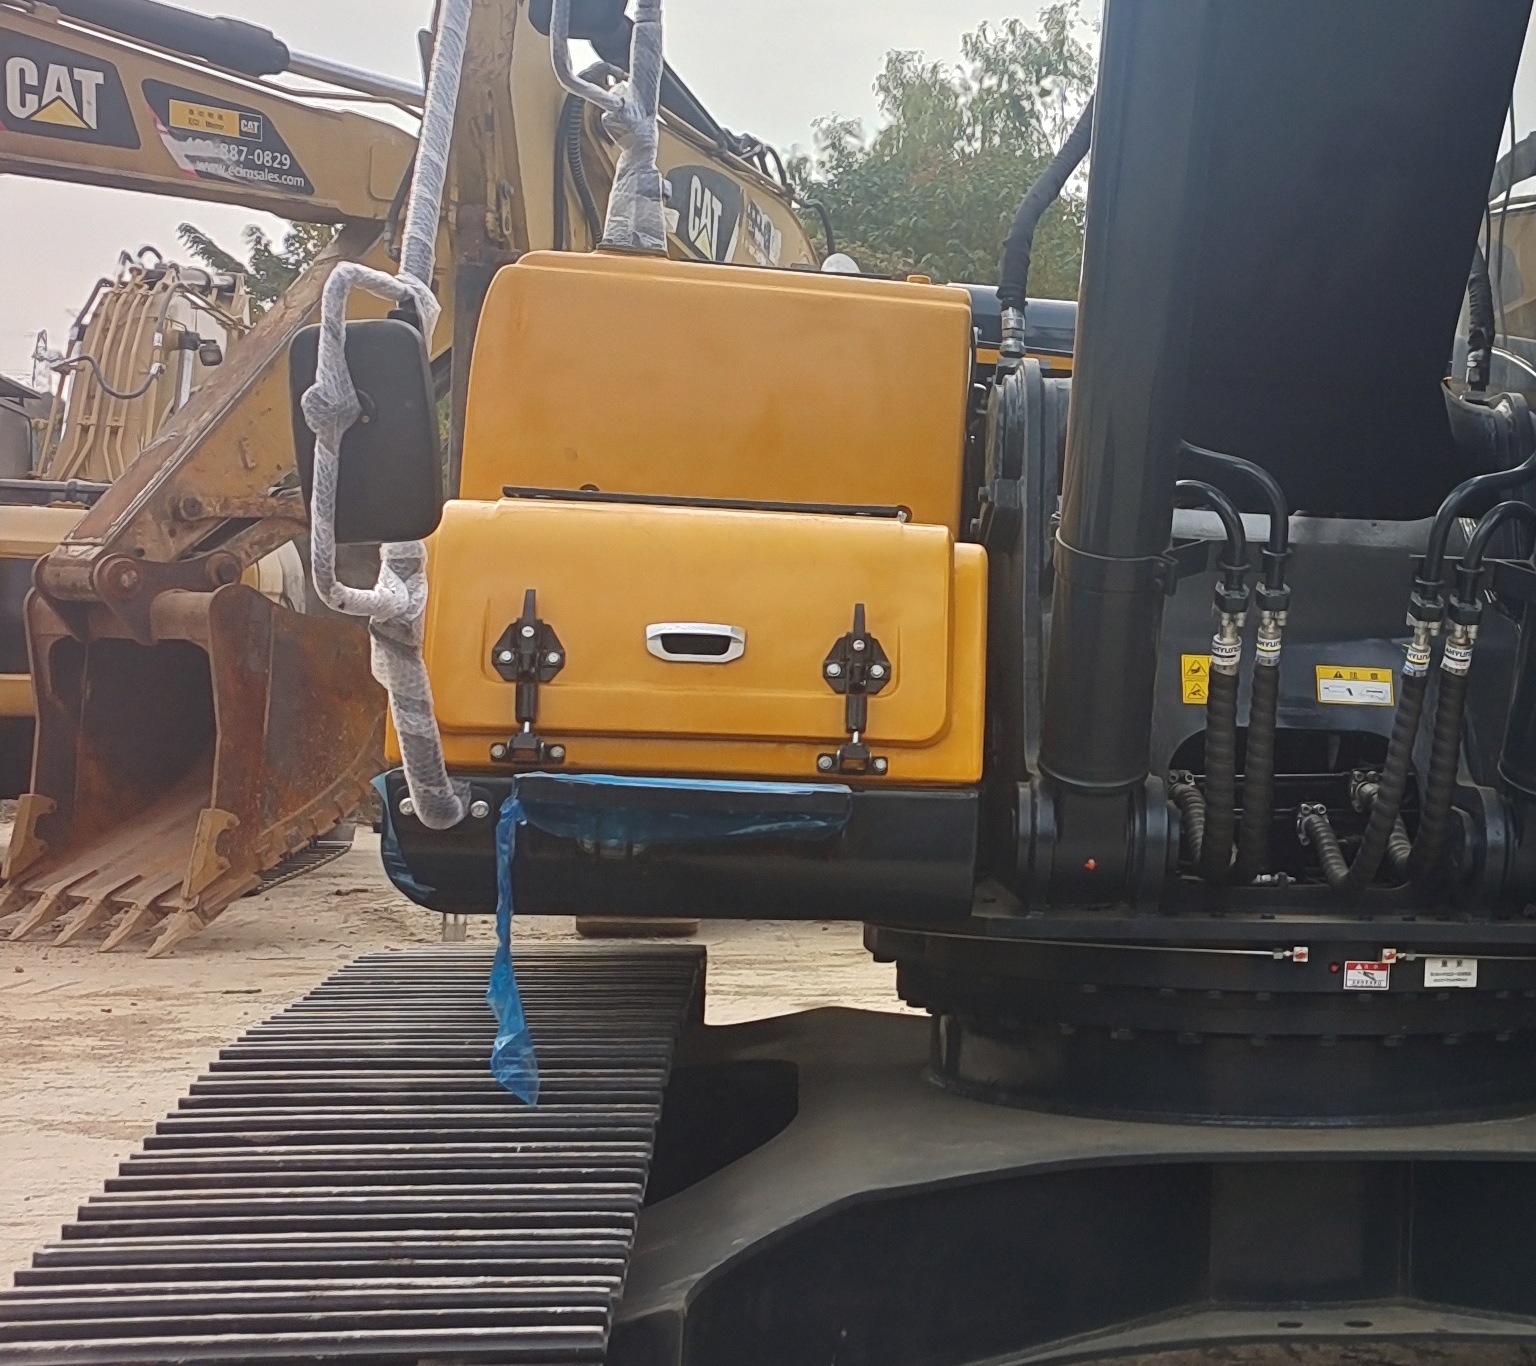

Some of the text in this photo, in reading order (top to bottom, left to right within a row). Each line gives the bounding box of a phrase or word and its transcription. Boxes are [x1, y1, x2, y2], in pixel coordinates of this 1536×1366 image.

[5, 56, 104, 130] CAT
[240, 119, 260, 134] CAT
[688, 174, 723, 261] CAT
